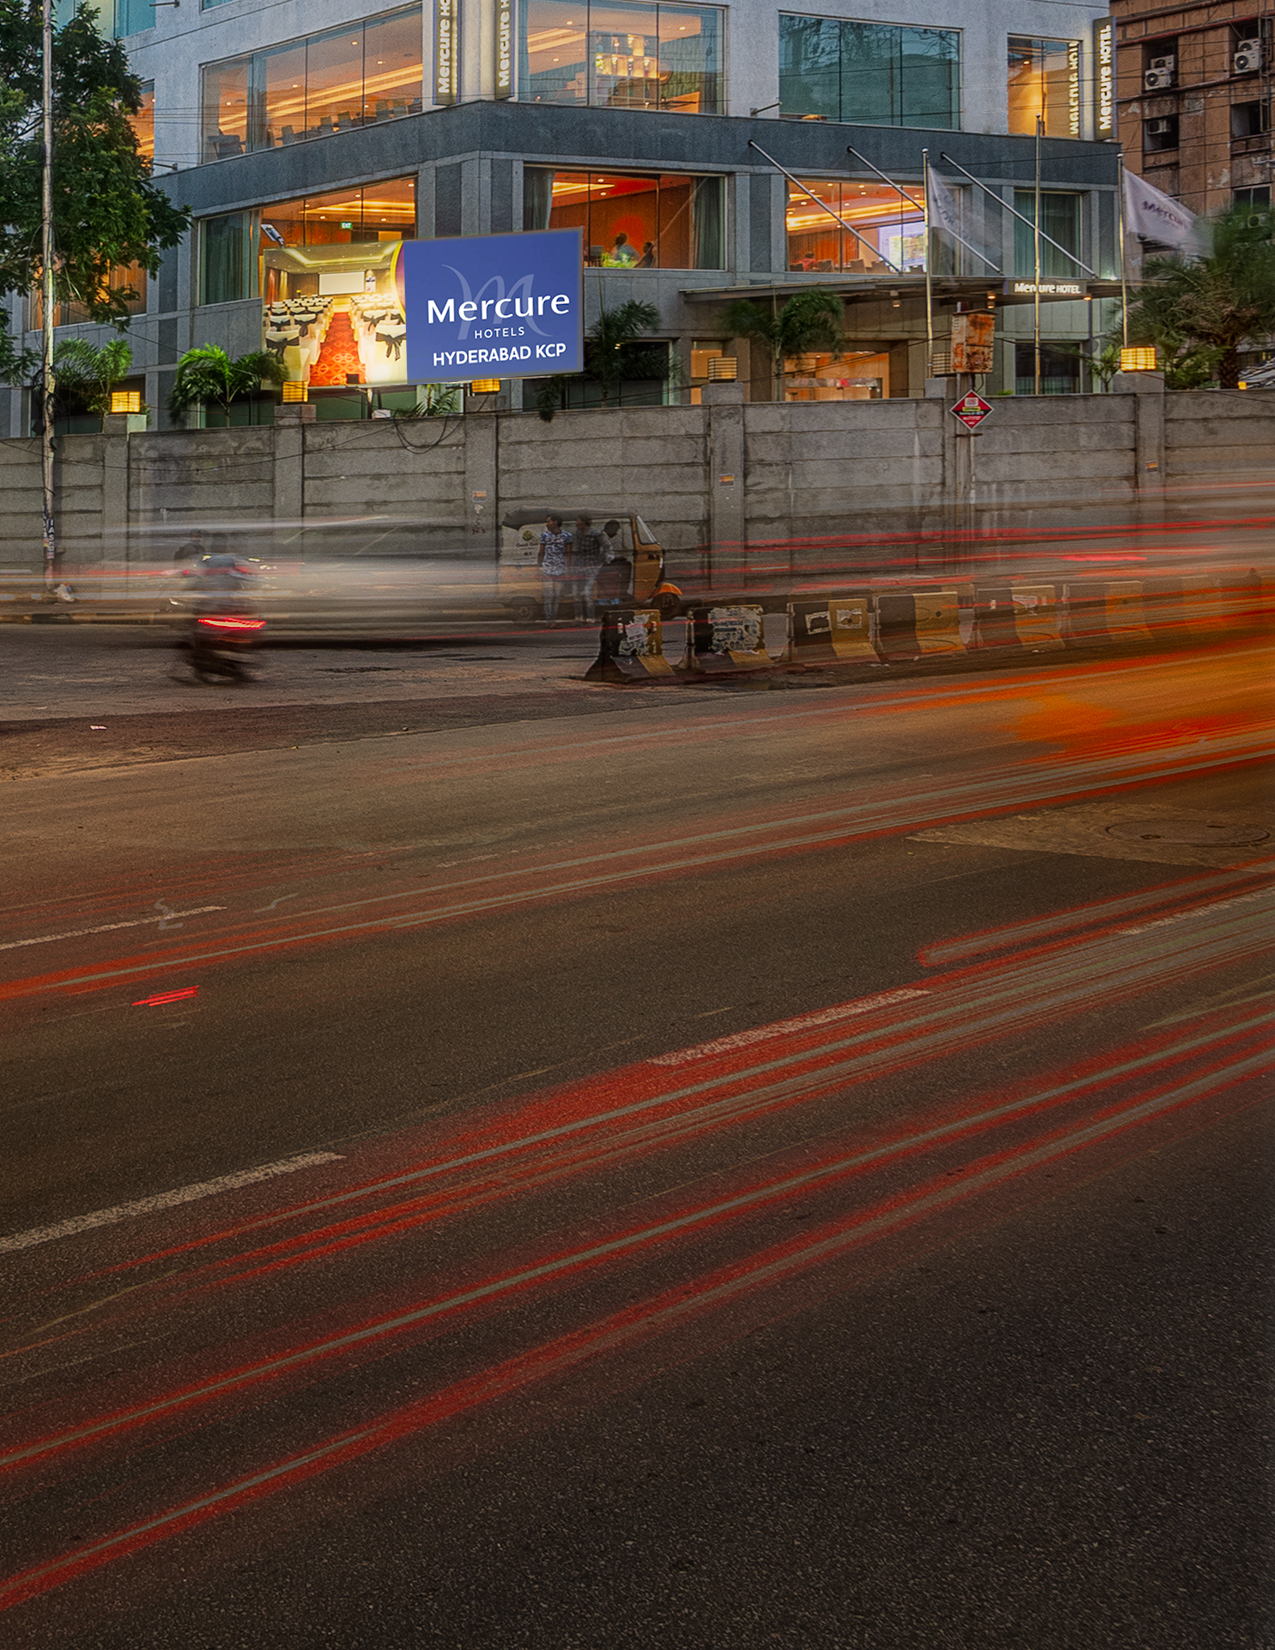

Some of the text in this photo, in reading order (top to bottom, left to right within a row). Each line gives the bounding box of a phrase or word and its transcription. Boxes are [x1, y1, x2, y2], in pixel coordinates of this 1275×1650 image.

[438, 18, 451, 94] Mercure
[499, 10, 510, 87] Mercure
[1099, 24, 1112, 130] Mercure HOTEL
[1056, 285, 1081, 294] HOTEL
[427, 293, 570, 324] Mercure
[474, 326, 525, 339] HOTELS
[433, 342, 567, 367] HYDERABAD KCP
